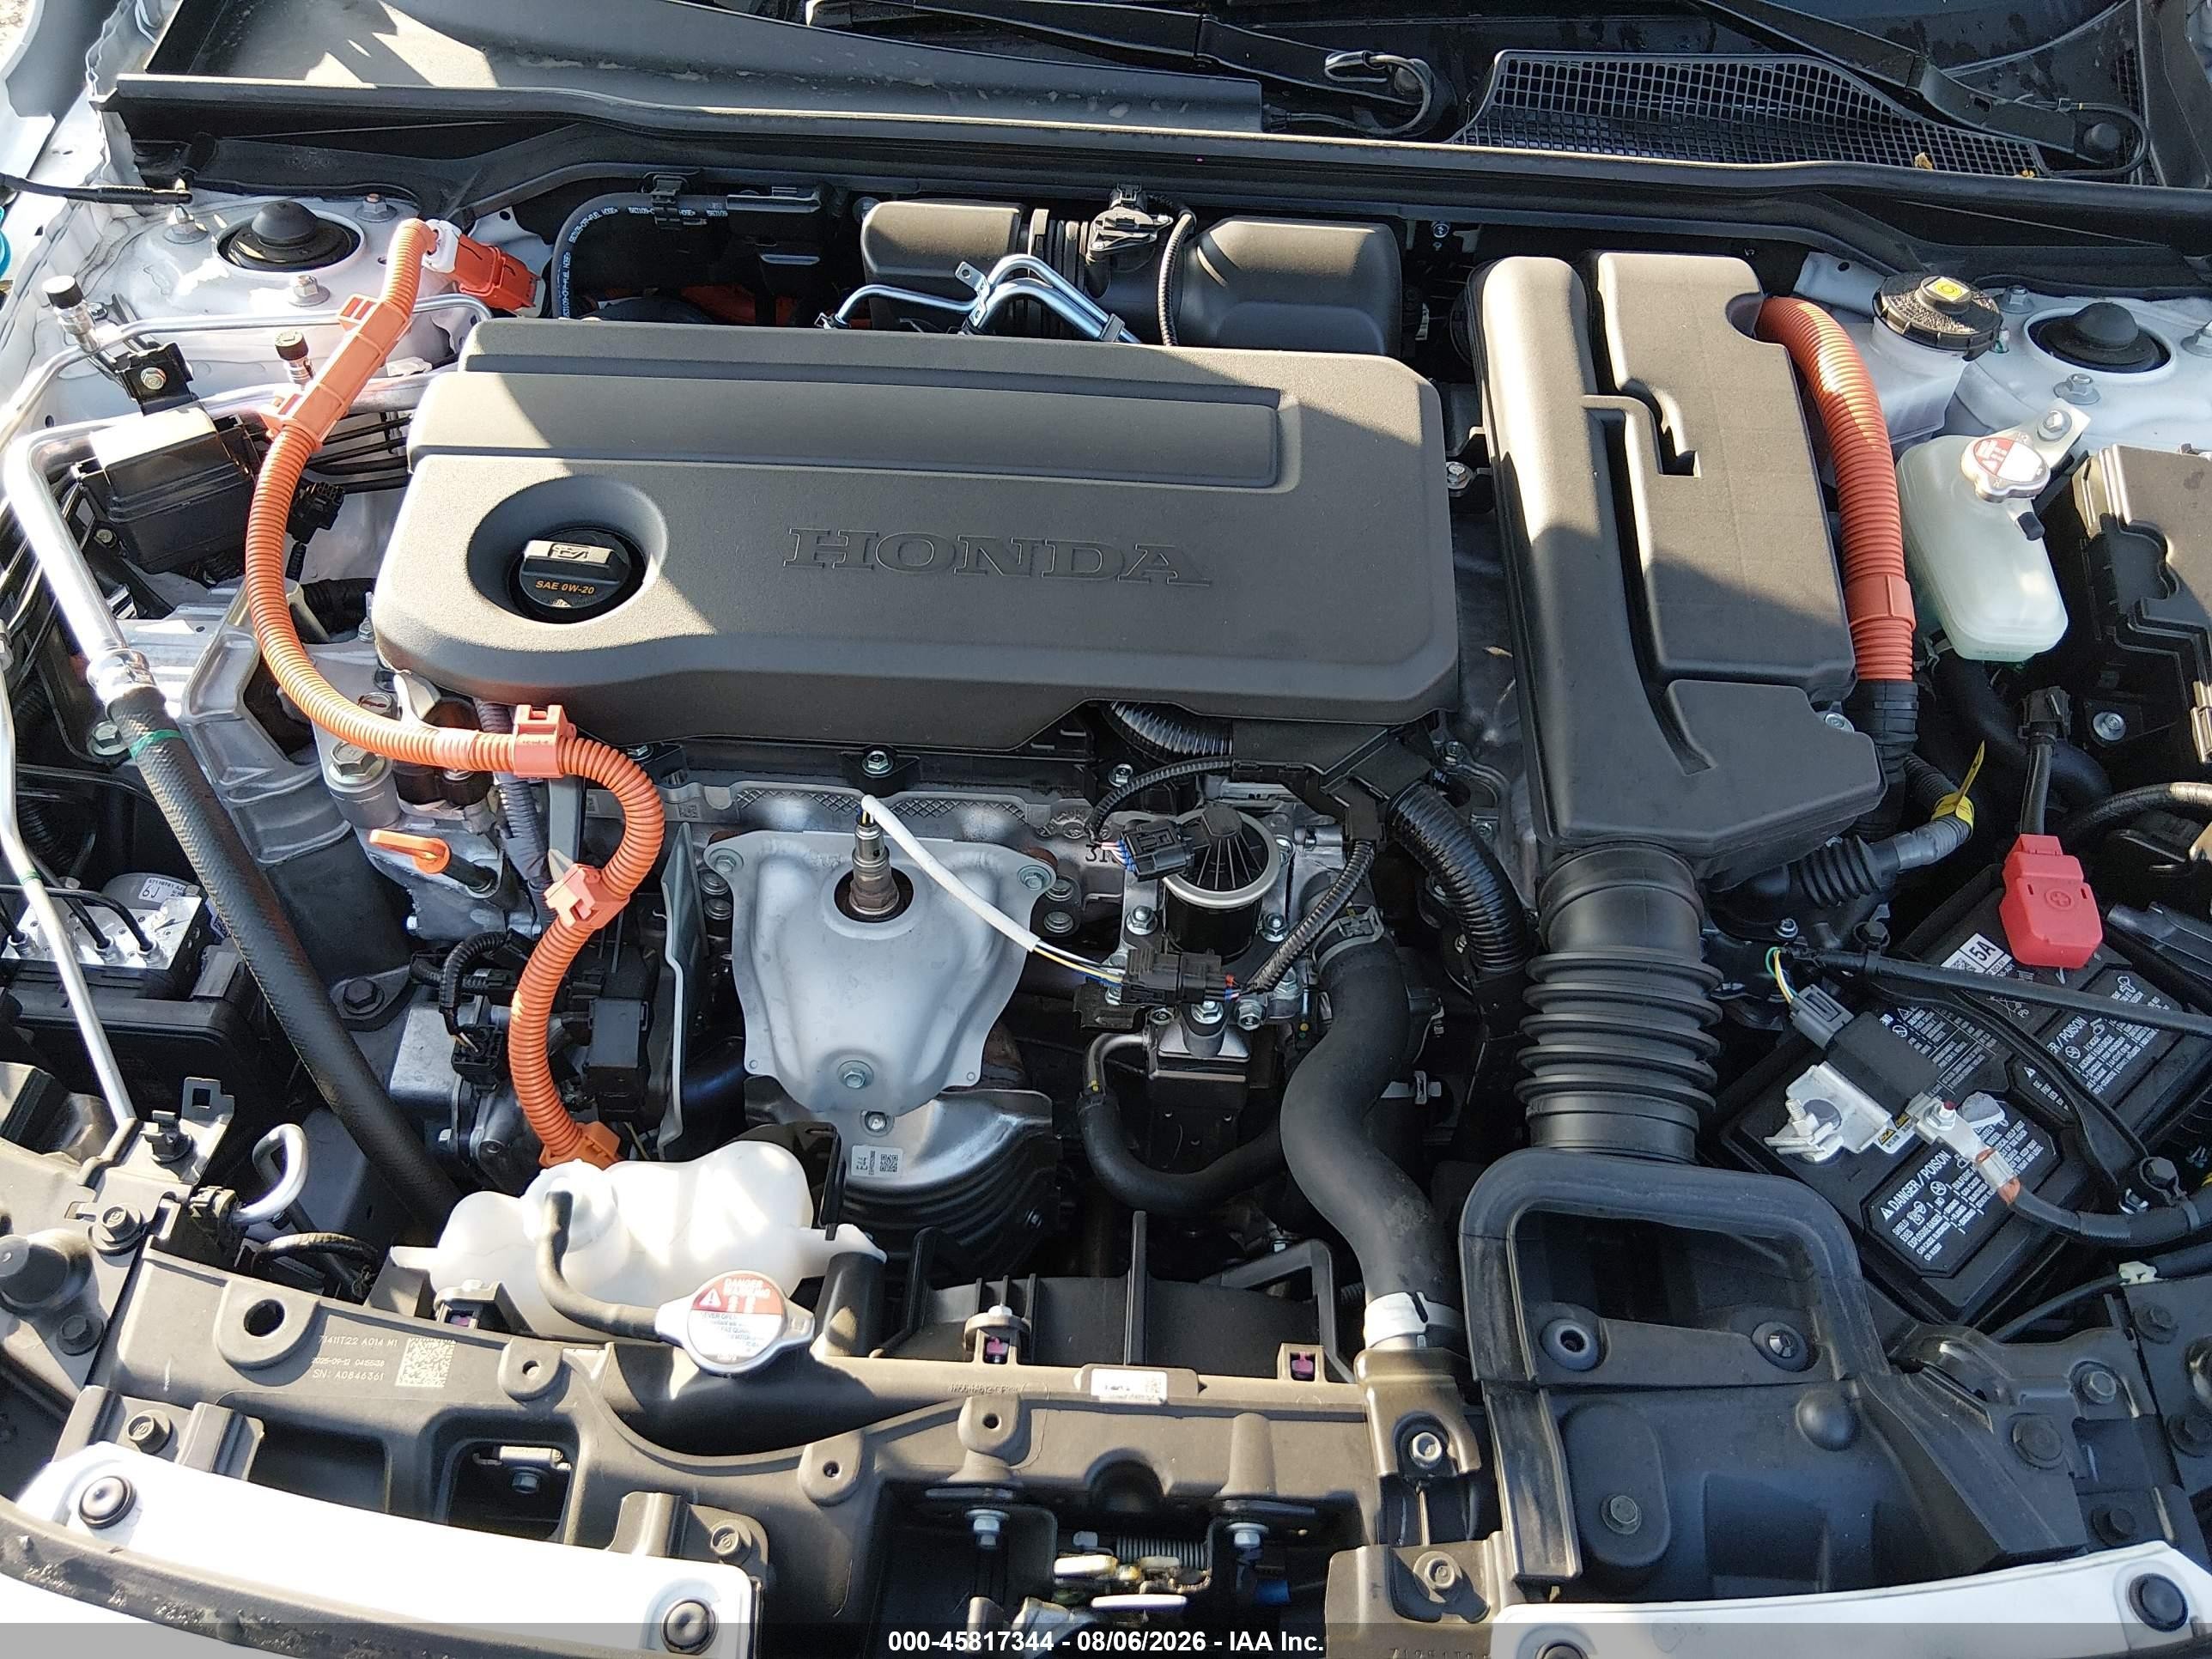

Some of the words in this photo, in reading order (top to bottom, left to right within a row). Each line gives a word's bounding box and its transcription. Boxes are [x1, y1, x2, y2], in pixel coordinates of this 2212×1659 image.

[783, 527, 1211, 587] HONDA
[535, 580, 559, 590] SAE
[561, 583, 594, 594] 0W-20
[142, 884, 161, 898] 6J
[1970, 939, 1996, 963] 5A
[361, 1337, 384, 1346] A014
[335, 1371, 385, 1381] A0846361
